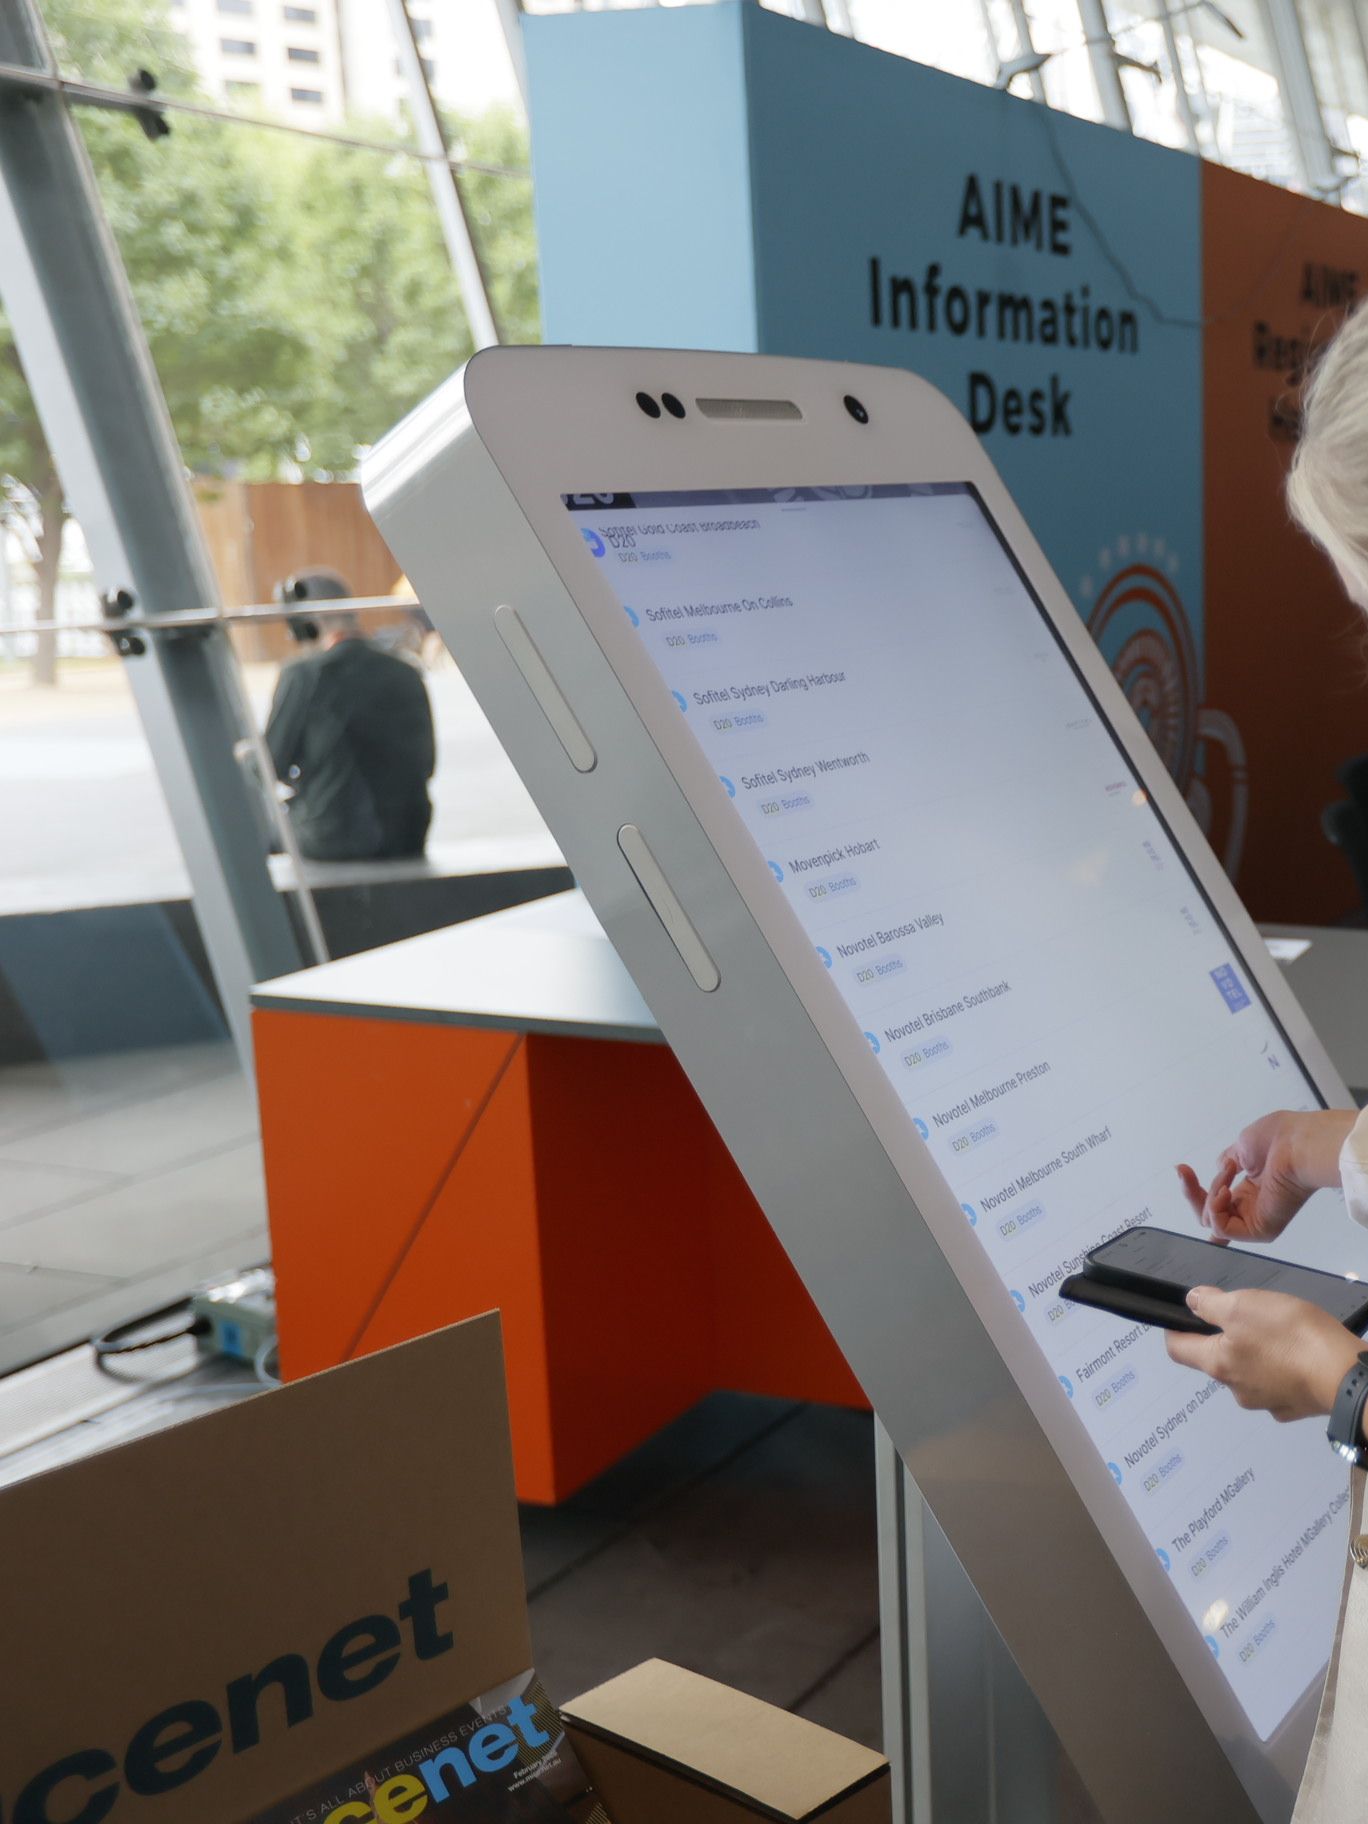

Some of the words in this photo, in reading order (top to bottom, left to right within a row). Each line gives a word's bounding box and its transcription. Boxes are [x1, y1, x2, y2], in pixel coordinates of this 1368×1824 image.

[956, 172, 1073, 258] AIME
[869, 256, 1139, 355] Information
[968, 370, 1073, 438] Desk
[646, 607, 683, 622] Sofitel
[686, 602, 742, 619] Melbourne
[742, 599, 759, 611] On
[758, 595, 794, 610] Collins
[666, 635, 686, 648] D20
[687, 632, 718, 645] Booths
[693, 684, 731, 706] Sofitel
[730, 682, 771, 700] Sydney
[770, 677, 809, 694] Darling
[808, 671, 847, 688] Harbour
[713, 718, 733, 732] D20
[734, 713, 764, 727] Booths
[741, 771, 778, 790] Sofitel
[776, 766, 817, 784] Sydney
[815, 751, 871, 774] Wentworth
[760, 802, 780, 815] D20
[781, 794, 811, 810] Booths
[844, 838, 881, 858] Hobart
[808, 885, 828, 898] D20
[828, 876, 857, 893] Booths
[836, 934, 878, 959] Novotel
[876, 923, 916, 945] Barossa
[914, 912, 945, 931] Valley
[856, 969, 875, 983] D20
[875, 959, 904, 976] Booths
[884, 1016, 924, 1043] Novotel
[923, 1001, 965, 1027] Brisbane
[962, 980, 1013, 1010] Southbank
[903, 1053, 922, 1067] D20
[922, 1040, 950, 1059] Booths
[932, 1102, 972, 1128] Novotel
[969, 1076, 1017, 1109] Melbourne
[1015, 1060, 1051, 1085] Preston
[951, 1136, 970, 1152] D20
[969, 1121, 997, 1143] Booths
[980, 1184, 1018, 1212] Novotel
[1016, 1156, 1064, 1192] Melbourne
[1061, 1141, 1088, 1165] South
[1085, 1126, 1113, 1152] Wharf
[1000, 1221, 1017, 1236] D20
[1016, 1205, 1043, 1226] Booths
[1028, 1264, 1065, 1298] Novotel
[1124, 1206, 1153, 1228] Resort
[1047, 1305, 1065, 1321] D20
[1075, 1346, 1117, 1384] Fairmont
[1112, 1324, 1144, 1353] Resort
[1095, 1390, 1112, 1407] D20
[1111, 1371, 1136, 1393] Booths
[1123, 1432, 1160, 1469] Novotel
[1156, 1408, 1188, 1439] Sydney
[1186, 1399, 1199, 1414] on
[1143, 1473, 1160, 1492] D20
[1158, 1454, 1182, 1478] Booths
[1171, 1530, 1192, 1553] The
[1188, 1501, 1223, 1537] Playford
[1219, 1466, 1257, 1506] MGallery
[1191, 1559, 1208, 1577] D20
[1206, 1536, 1229, 1561] Booths
[1219, 1617, 1239, 1639] The
[1235, 1585, 1267, 1619] William
[1262, 1564, 1285, 1594] Inglis
[1281, 1541, 1303, 1568] Hotel
[1300, 1510, 1333, 1548] MGallery
[1238, 1643, 1255, 1663] D20
[0, 1567, 455, 1824] cenet
[320, 1795, 345, 1813] ALL
[348, 1766, 391, 1798] ABOUT
[394, 1731, 458, 1771] BUSINESS
[460, 1706, 509, 1737] EVENTS
